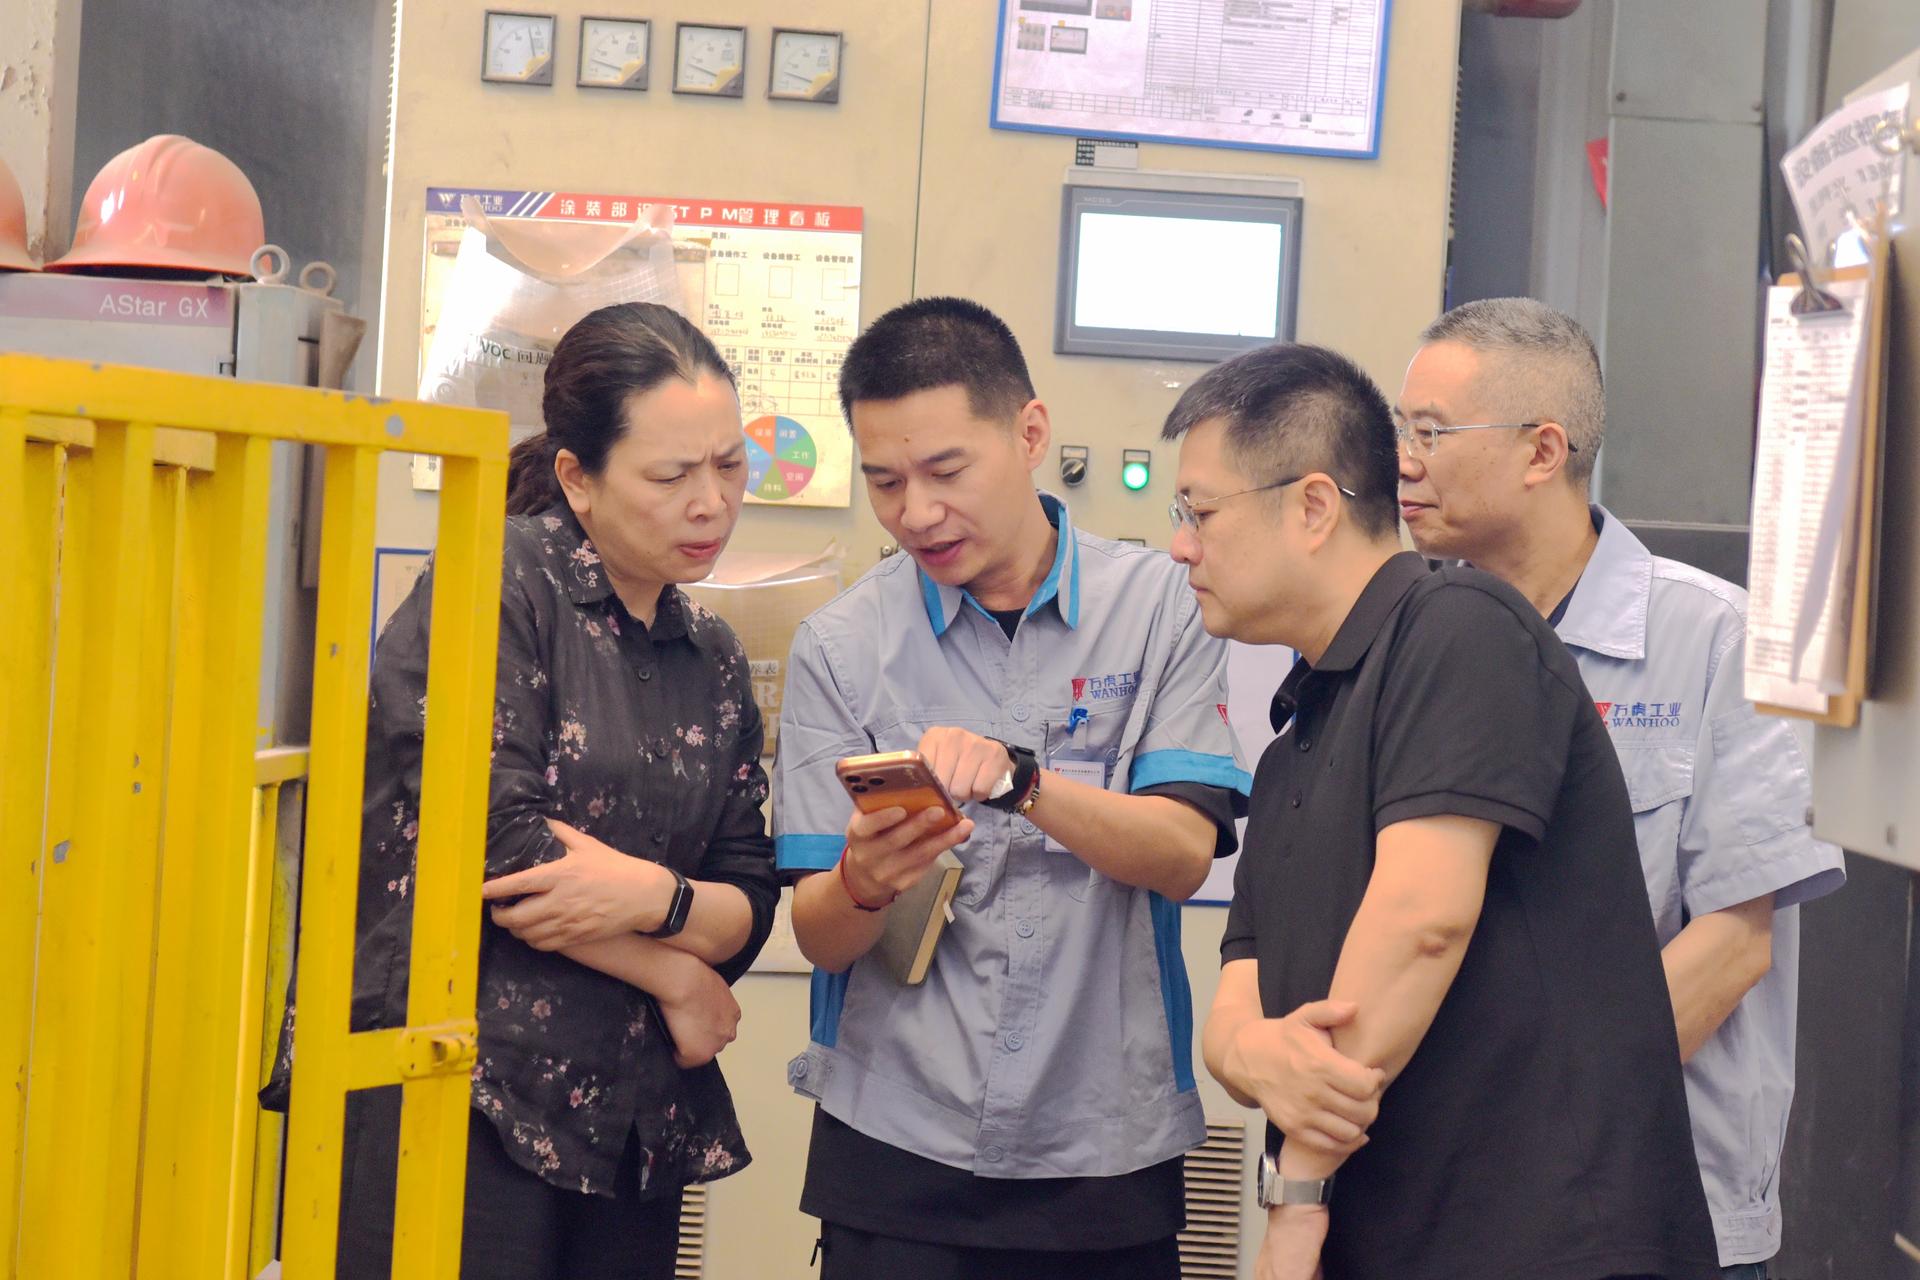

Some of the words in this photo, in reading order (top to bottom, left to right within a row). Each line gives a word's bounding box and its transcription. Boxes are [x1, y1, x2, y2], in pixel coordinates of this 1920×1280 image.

[99, 294, 167, 316] AStar
[178, 297, 209, 318] GX
[481, 340, 511, 360] VOC
[1612, 717, 1680, 728] WANHOO
